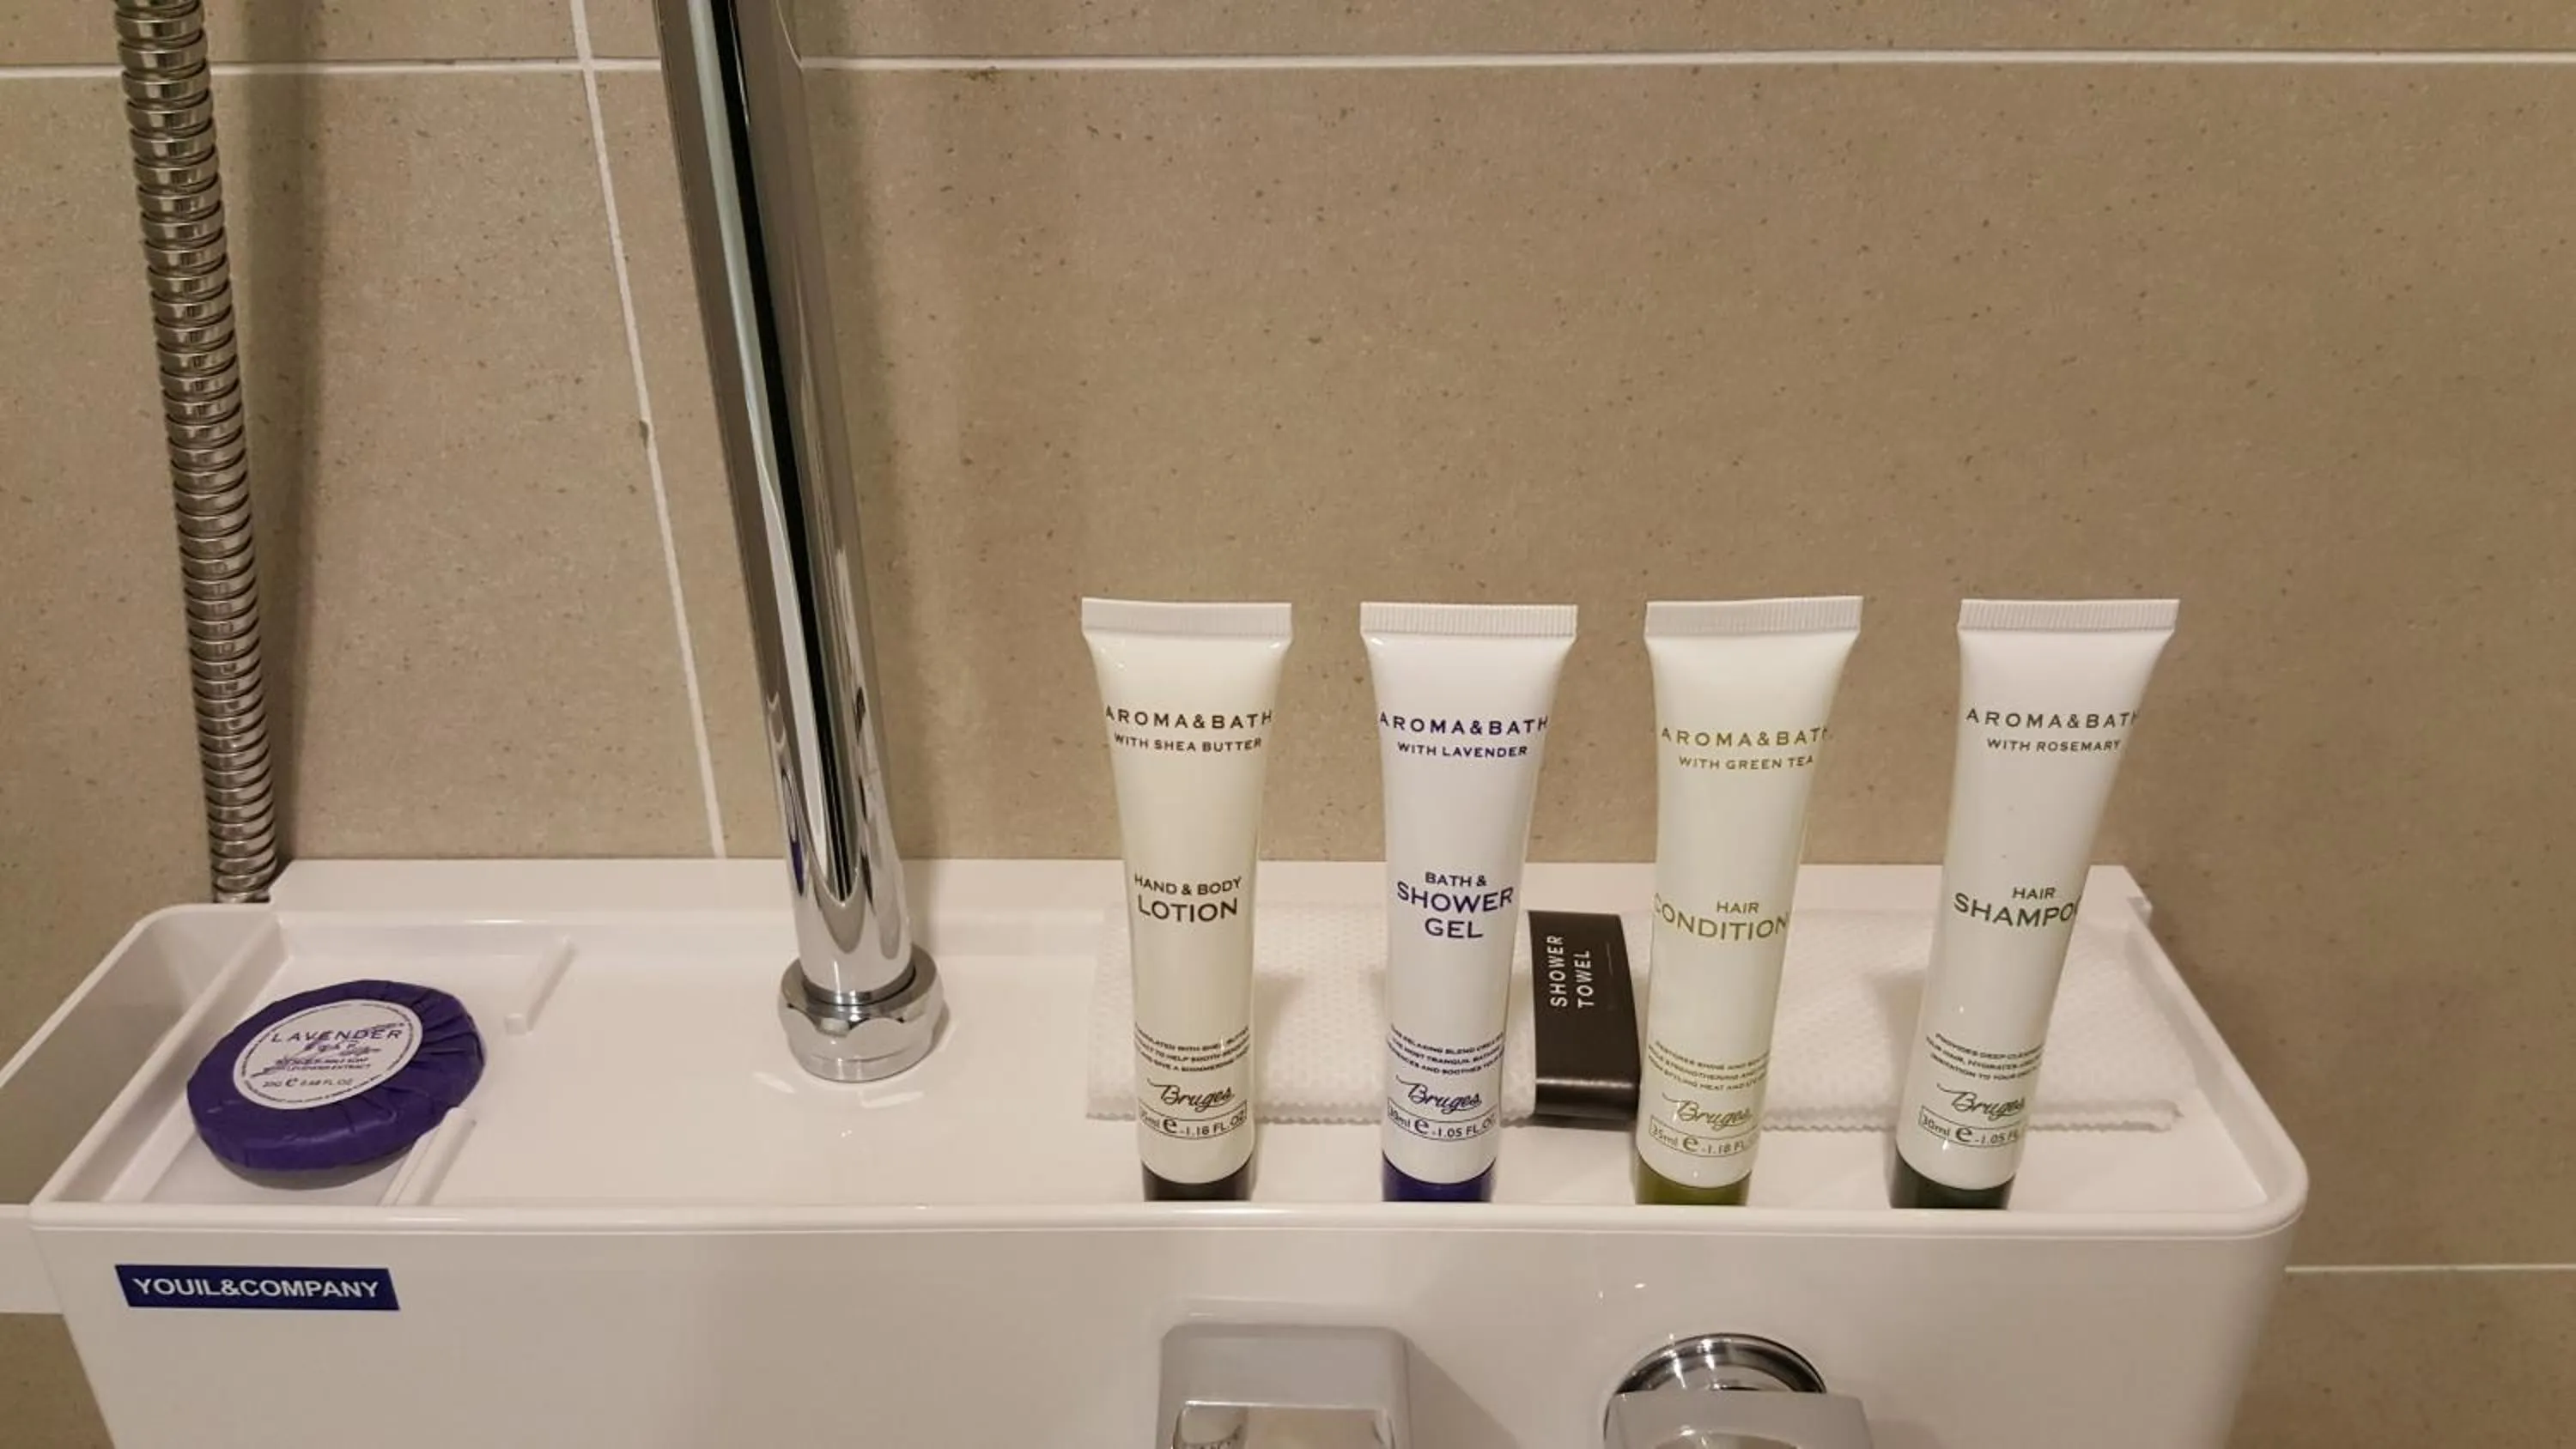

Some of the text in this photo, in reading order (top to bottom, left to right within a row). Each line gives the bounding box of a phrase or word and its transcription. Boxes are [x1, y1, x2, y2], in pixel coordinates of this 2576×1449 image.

[1105, 705, 1273, 729] AROMA&BATH
[1379, 711, 1548, 736] AROMA&BATH
[1114, 732, 1262, 753] WITH SHEA BUTTER
[1397, 741, 1528, 758] WITH LAVENDER
[1987, 737, 2121, 753] WITH ROSEMARY
[1679, 755, 1814, 770] WITH GREEN TEA
[1134, 872, 1242, 895] HAND & BODY
[1425, 871, 1487, 888] BATH &
[1396, 880, 1514, 913] SHOWER
[2012, 887, 2055, 900] HAIR
[1138, 894, 1237, 923] LOTION
[1716, 900, 1759, 915] HAIR
[1953, 891, 2078, 928] SHAMPO
[1425, 917, 1484, 939] GEL
[1546, 935, 1568, 1008] SHOWER
[1574, 949, 1595, 1009] TOWEL
[271, 1028, 403, 1044] LAVENDER
[1146, 1077, 1236, 1113] Bruges
[1395, 1074, 1483, 1114] Bruges
[132, 1278, 379, 1297] YOUIL&COMPANY
